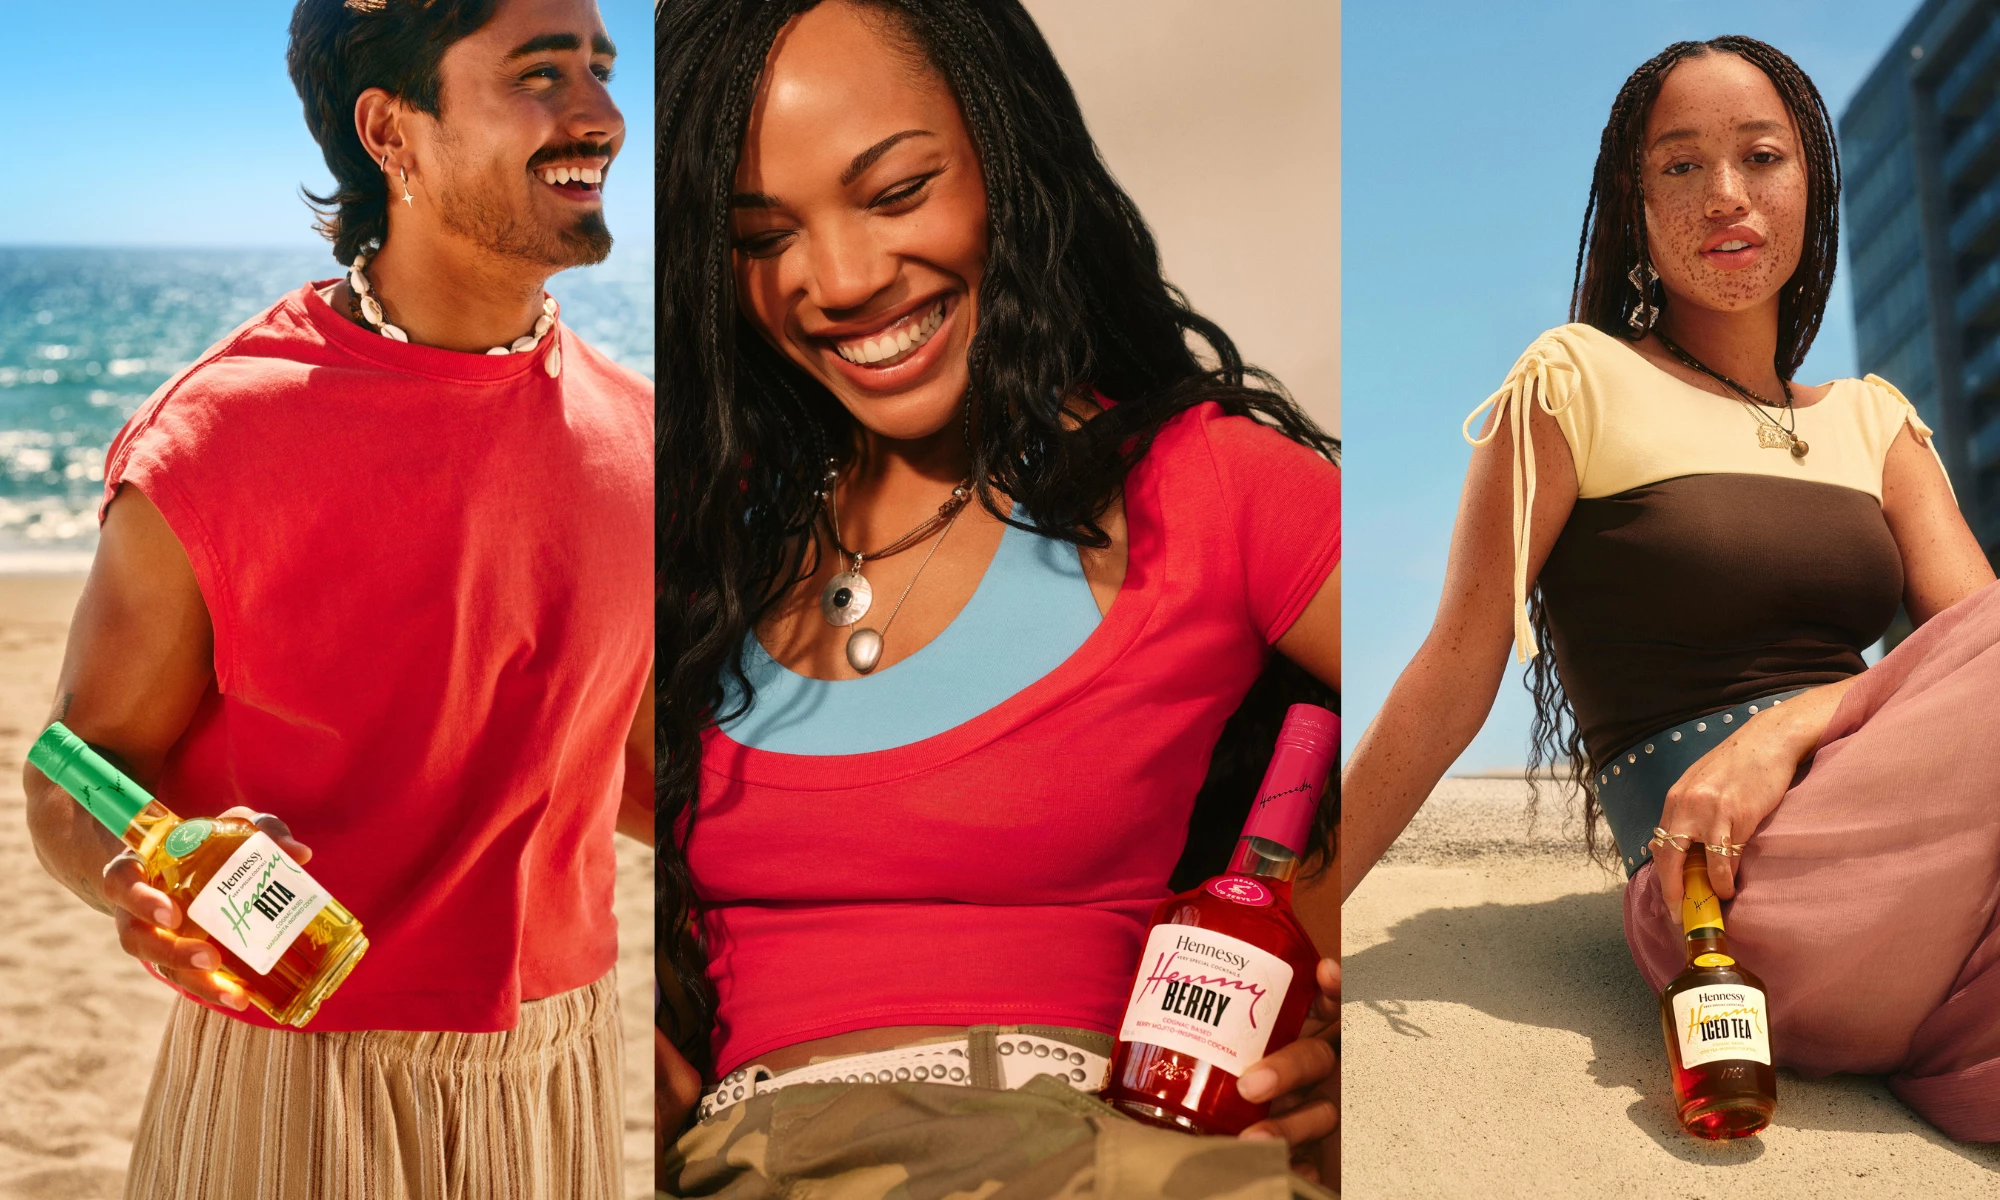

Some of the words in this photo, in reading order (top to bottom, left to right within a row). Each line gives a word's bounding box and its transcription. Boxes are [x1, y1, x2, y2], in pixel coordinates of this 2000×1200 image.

[217, 849, 263, 896] Hennessy
[220, 851, 302, 948] Henny
[253, 880, 296, 922] RITA
[1176, 935, 1250, 971] Hennessy
[1189, 957, 1209, 967] SPECIAL
[1210, 963, 1241, 978] COCKTAILS
[1136, 951, 1266, 1030] Henny
[1161, 980, 1231, 1027] BERRY
[1699, 993, 1746, 1003] Hennessy
[1162, 1017, 1190, 1030] COGNAC
[1190, 1025, 1212, 1037] BASED
[1687, 1004, 1762, 1044] Henny
[1700, 1018, 1730, 1041] ICED
[1731, 1018, 1752, 1040] TEA
